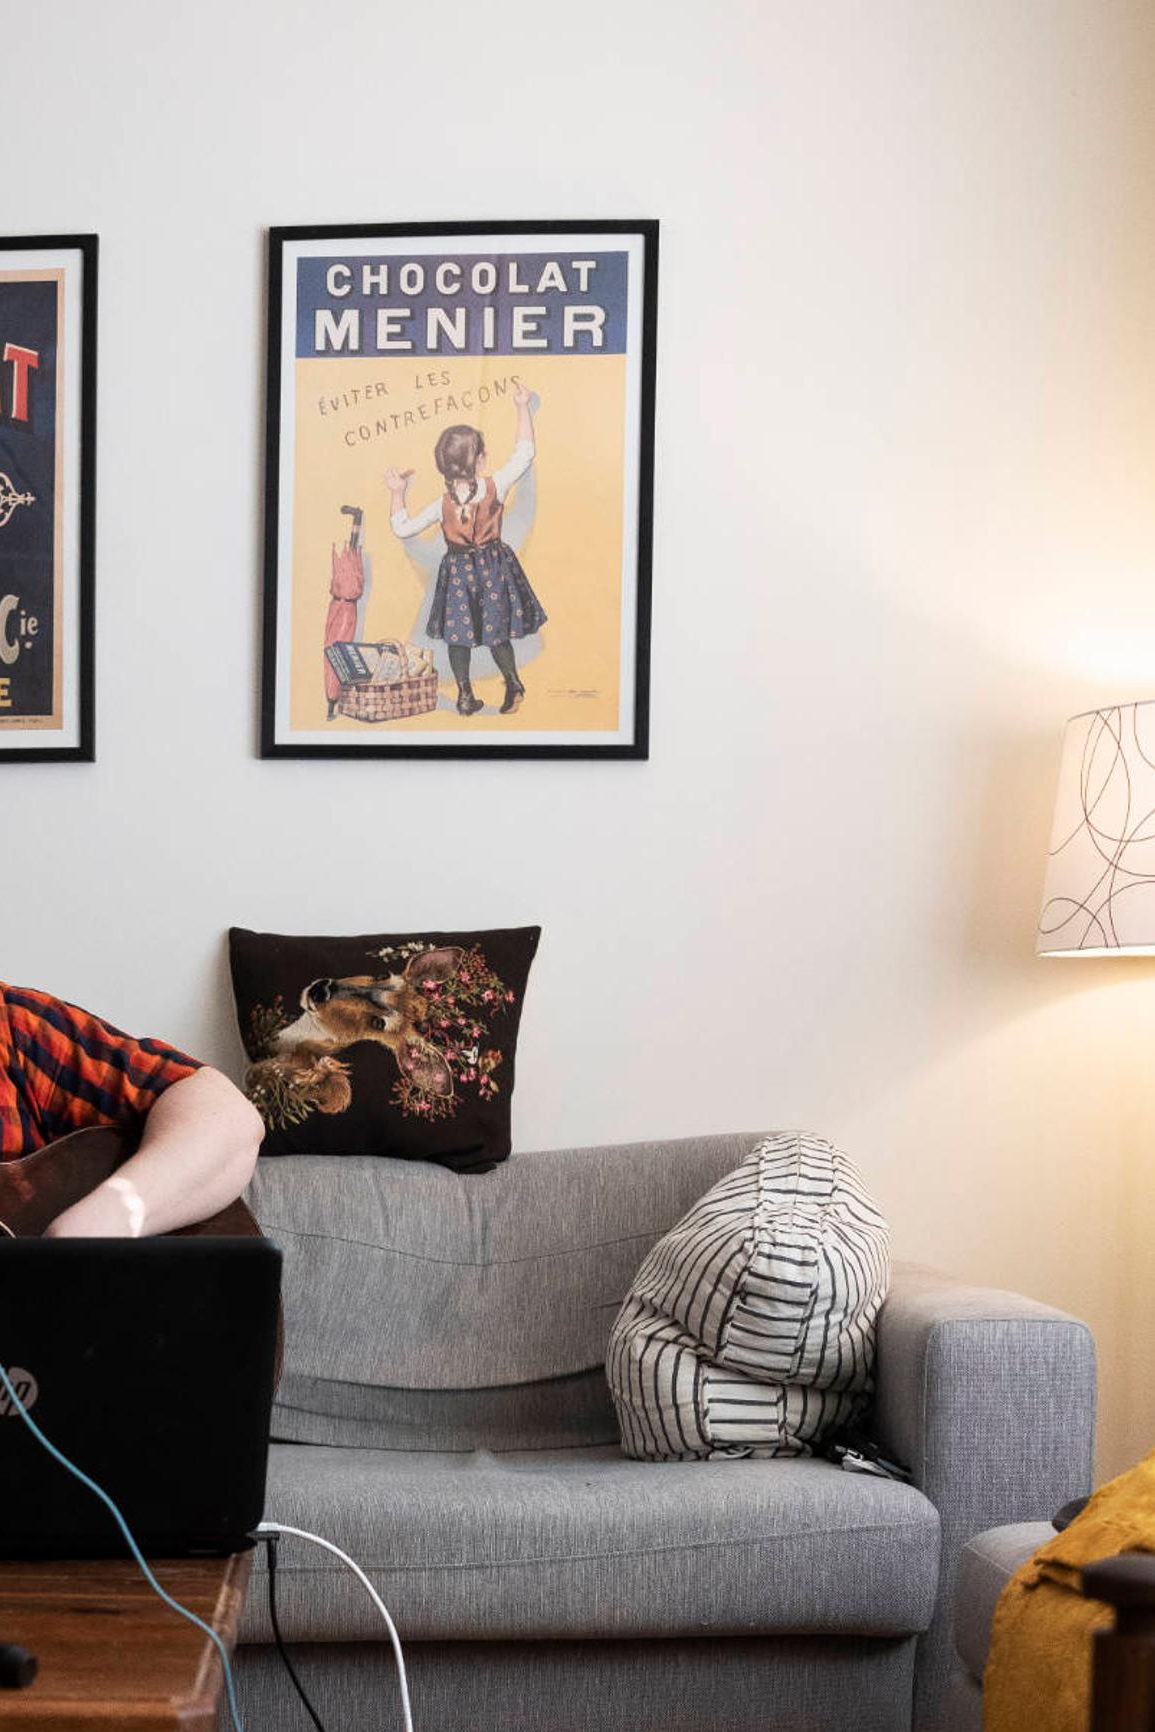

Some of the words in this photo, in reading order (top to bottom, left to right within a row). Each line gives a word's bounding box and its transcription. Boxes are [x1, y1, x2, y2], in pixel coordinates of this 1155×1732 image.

[326, 260, 596, 297] CHOCOLAT
[314, 305, 606, 351] MENIER
[415, 371, 451, 389] LES
[344, 375, 520, 447] CONTREFAÇONS
